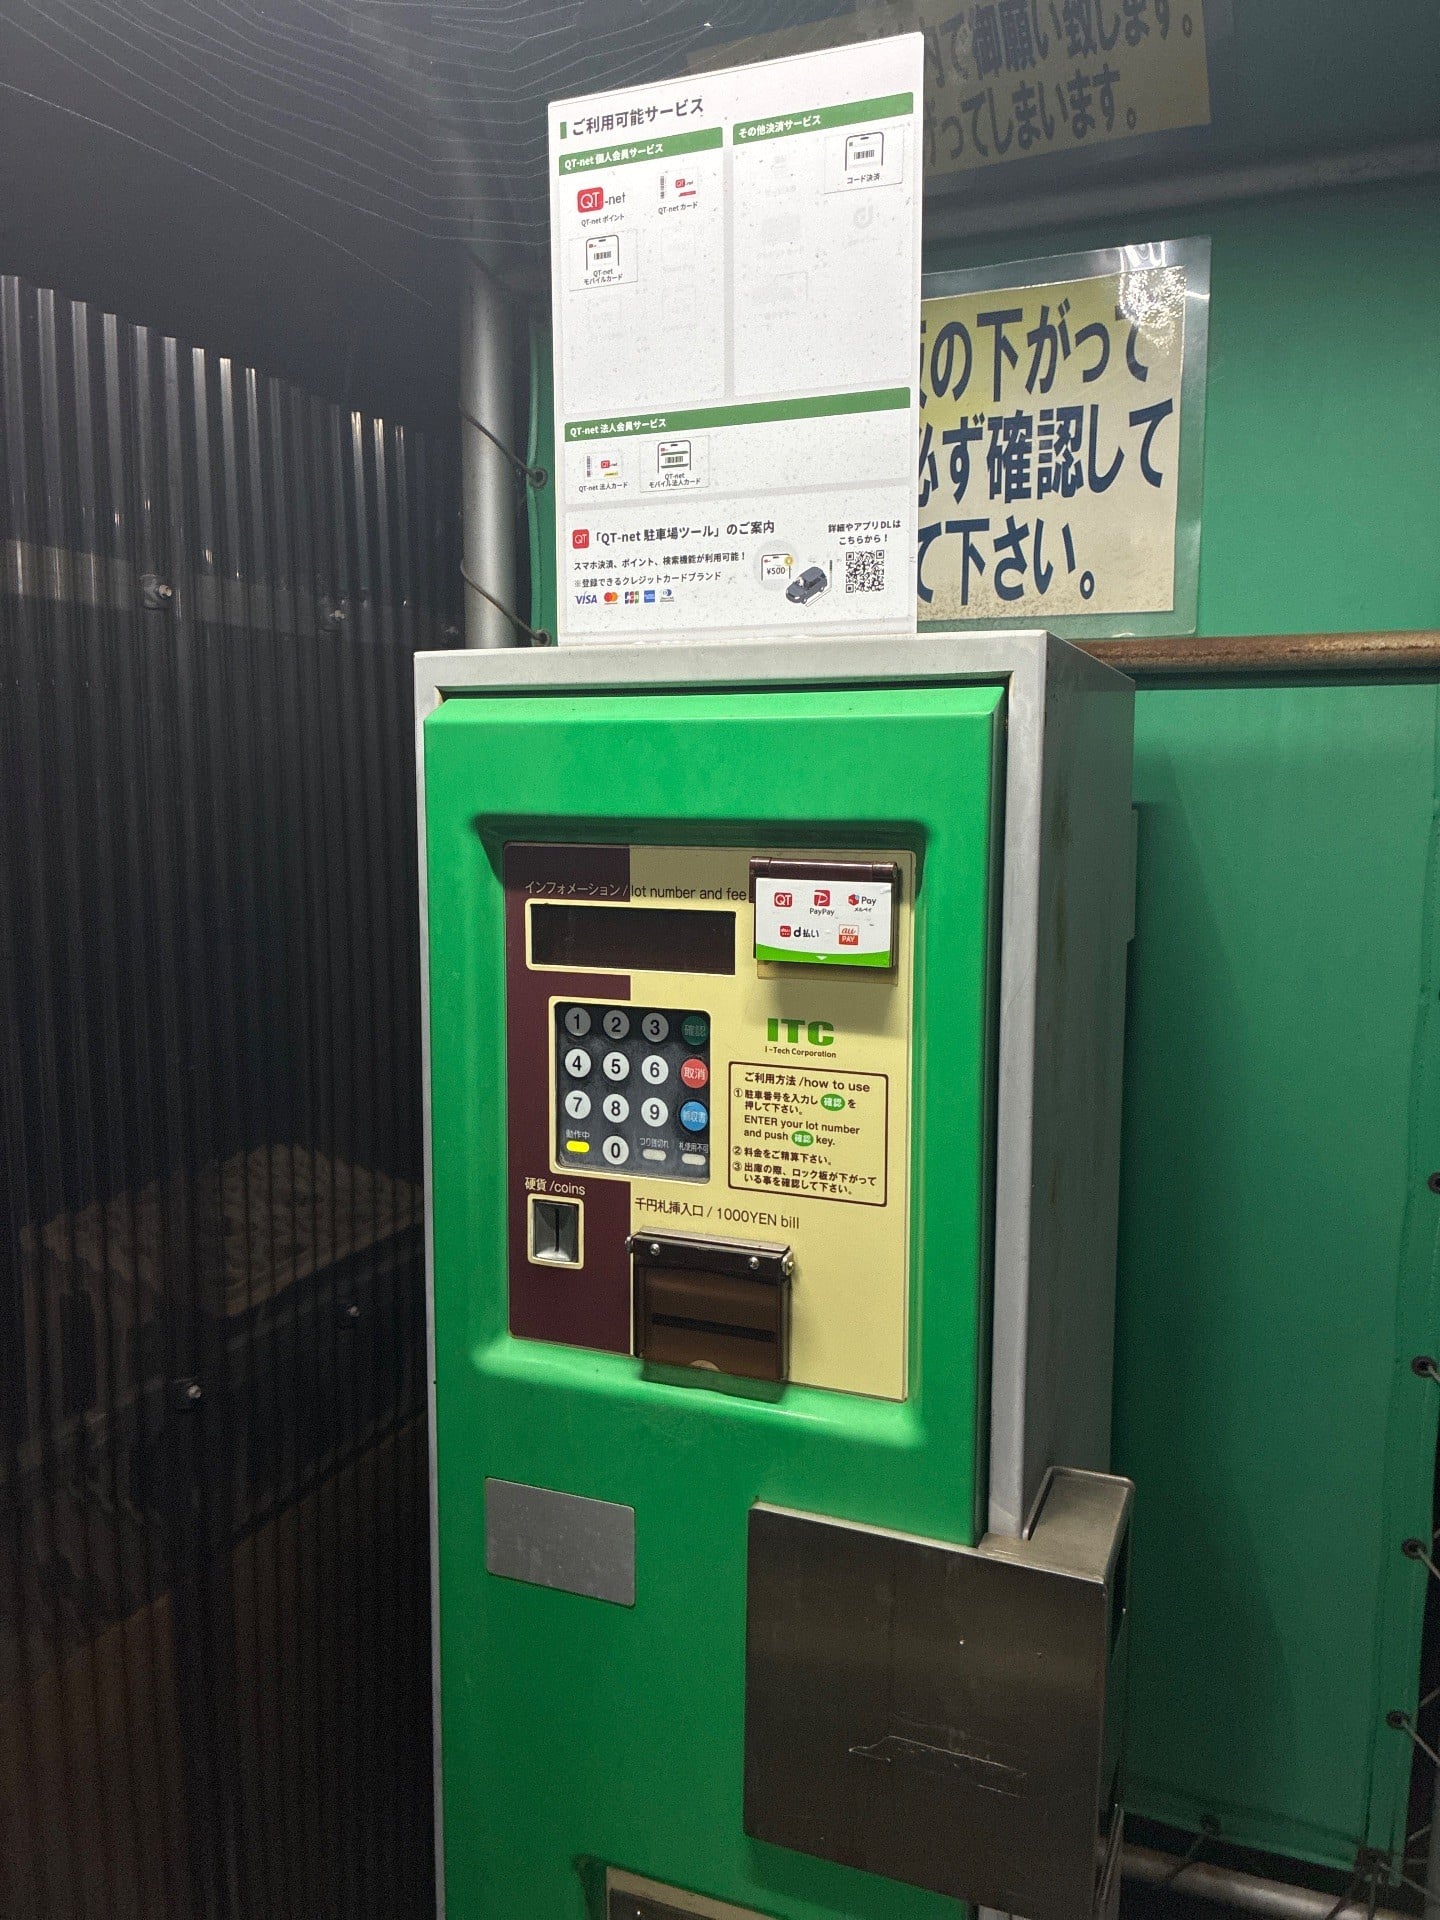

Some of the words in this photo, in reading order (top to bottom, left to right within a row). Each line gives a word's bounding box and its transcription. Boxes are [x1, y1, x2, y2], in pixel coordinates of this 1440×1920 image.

[572, 98, 704, 136] ご利用可能サービス
[738, 115, 822, 139] その他決済サービス
[564, 155, 595, 170] QT-net
[595, 143, 664, 165] 個人会員サービス
[847, 173, 881, 184] コード決済
[657, 205, 679, 215] QT-net
[680, 201, 698, 211] カード
[581, 217, 602, 227] QT-net
[602, 213, 625, 224] ポイント
[584, 274, 623, 286] モバイルカード
[593, 268, 613, 278] QT-net
[569, 427, 599, 438] QT-net
[600, 418, 667, 434] 法人会員サービス
[649, 478, 701, 489] モバイル法人カード
[665, 472, 685, 480] QT-net
[578, 484, 599, 493] QT-net
[599, 481, 628, 490] 法人カード
[828, 519, 901, 534] 詳細やアプリDLは
[574, 532, 589, 547] QT
[575, 592, 598, 604] VISA
[631, 885, 647, 898] lot
[650, 886, 696, 899] number
[699, 888, 722, 900] and
[726, 887, 747, 901] fee
[775, 893, 792, 906] QT
[861, 896, 877, 906] Pay
[809, 908, 835, 916] PayPay
[573, 1014, 580, 1030] 1
[611, 1016, 622, 1033] 2
[650, 1019, 660, 1036] 3
[767, 1017, 835, 1047] ITC
[791, 1048, 837, 1059] Corporation
[572, 1055, 582, 1071] 4
[611, 1058, 621, 1075] 5
[650, 1061, 660, 1078] 6
[684, 1066, 706, 1081] 取消
[744, 1071, 796, 1087] ご利用方法
[833, 1080, 845, 1091] to
[848, 1082, 871, 1093] use
[572, 1096, 583, 1113] 7
[744, 1089, 818, 1105] 駐車番号を入力し
[611, 1100, 621, 1117] 8
[650, 1104, 660, 1121] 9
[744, 1101, 803, 1115] 押して下さい。
[744, 1115, 778, 1127] ENTER
[781, 1119, 803, 1131] your
[805, 1120, 819, 1131] lot
[821, 1123, 860, 1135] number
[744, 1129, 762, 1138] and
[764, 1131, 789, 1143] push
[816, 1135, 836, 1147] key.
[611, 1142, 621, 1159] 0
[744, 1147, 832, 1165] 料金をご精算下さい。
[744, 1162, 877, 1187] 出庫の際、ロック板が下がって
[744, 1174, 853, 1195] いる事を確認して下さい。
[635, 1197, 704, 1218] 千円札挿入口
[717, 1207, 777, 1227] 1000YEN
[780, 1215, 800, 1230] bill
